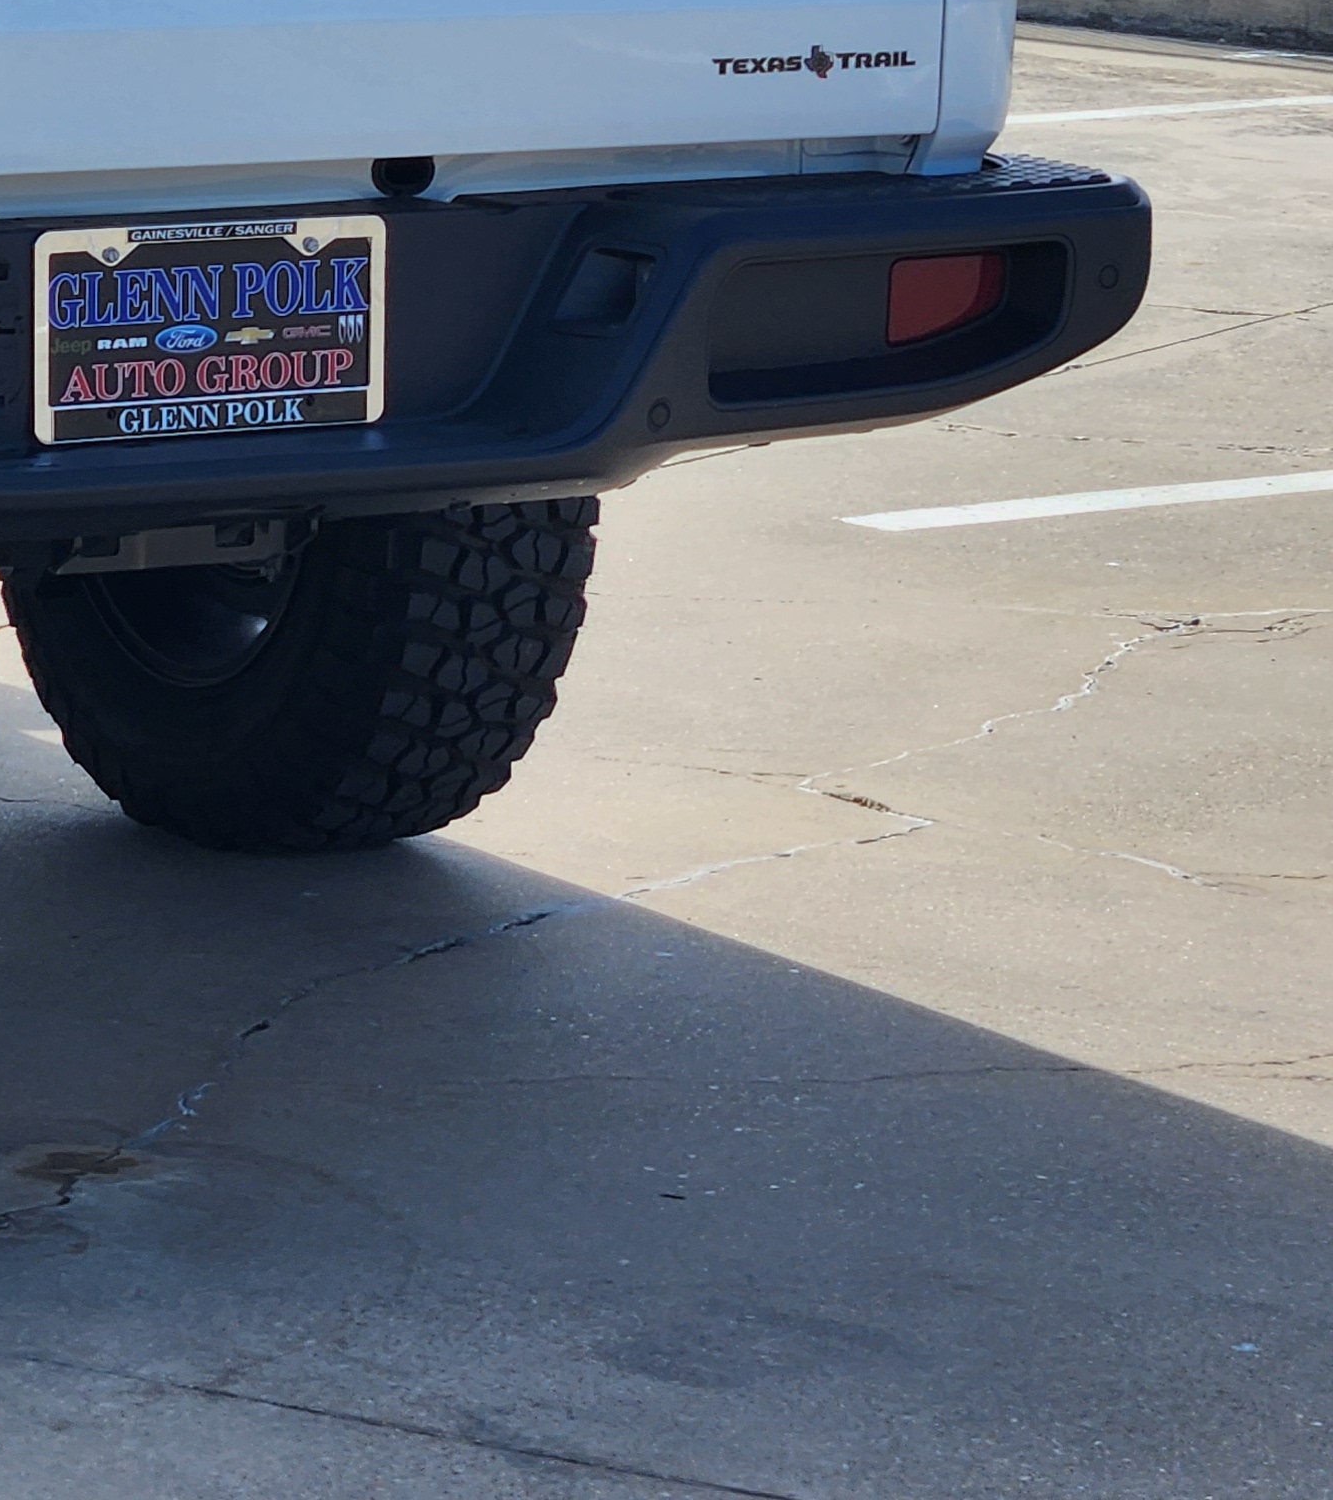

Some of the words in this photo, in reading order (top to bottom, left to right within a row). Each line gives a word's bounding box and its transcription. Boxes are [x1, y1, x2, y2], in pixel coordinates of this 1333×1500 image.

[712, 55, 802, 75] TEXAS
[835, 51, 916, 70] TRAIL
[48, 264, 223, 330] GLENN
[232, 257, 369, 320] POLK
[51, 338, 93, 356] Jeep
[96, 336, 148, 351] RAM
[164, 328, 208, 350] Ford
[282, 324, 332, 339] GMC
[60, 358, 186, 402] AUTO
[196, 348, 354, 395] GROUP
[118, 403, 229, 434] GLENN
[228, 398, 304, 427] POLK
